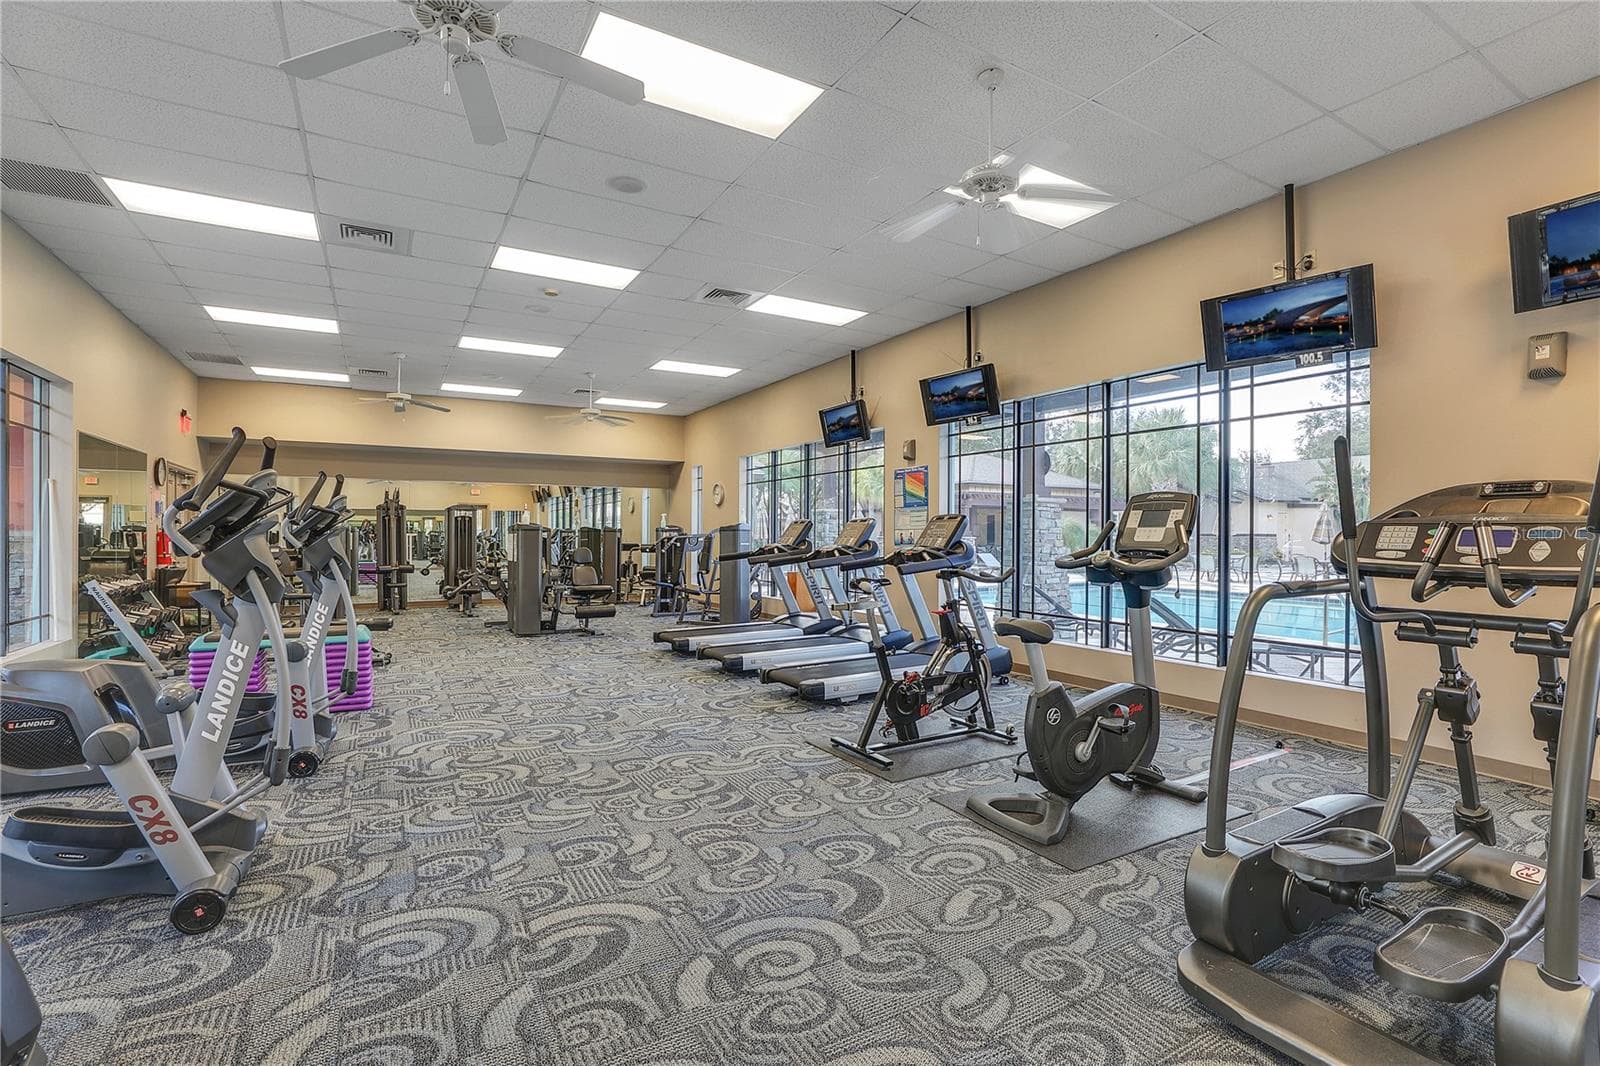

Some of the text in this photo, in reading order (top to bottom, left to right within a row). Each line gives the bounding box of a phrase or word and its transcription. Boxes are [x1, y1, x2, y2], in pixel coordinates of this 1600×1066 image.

[1299, 351, 1323, 365] 100.5
[91, 586, 114, 613] NAUTILUS
[804, 567, 827, 606] SPIRIT
[963, 580, 990, 630] SPIRIT
[201, 639, 250, 742] LANDICE
[290, 684, 308, 719] CX8
[15, 719, 56, 729] LANDICE
[127, 794, 179, 846] CX8
